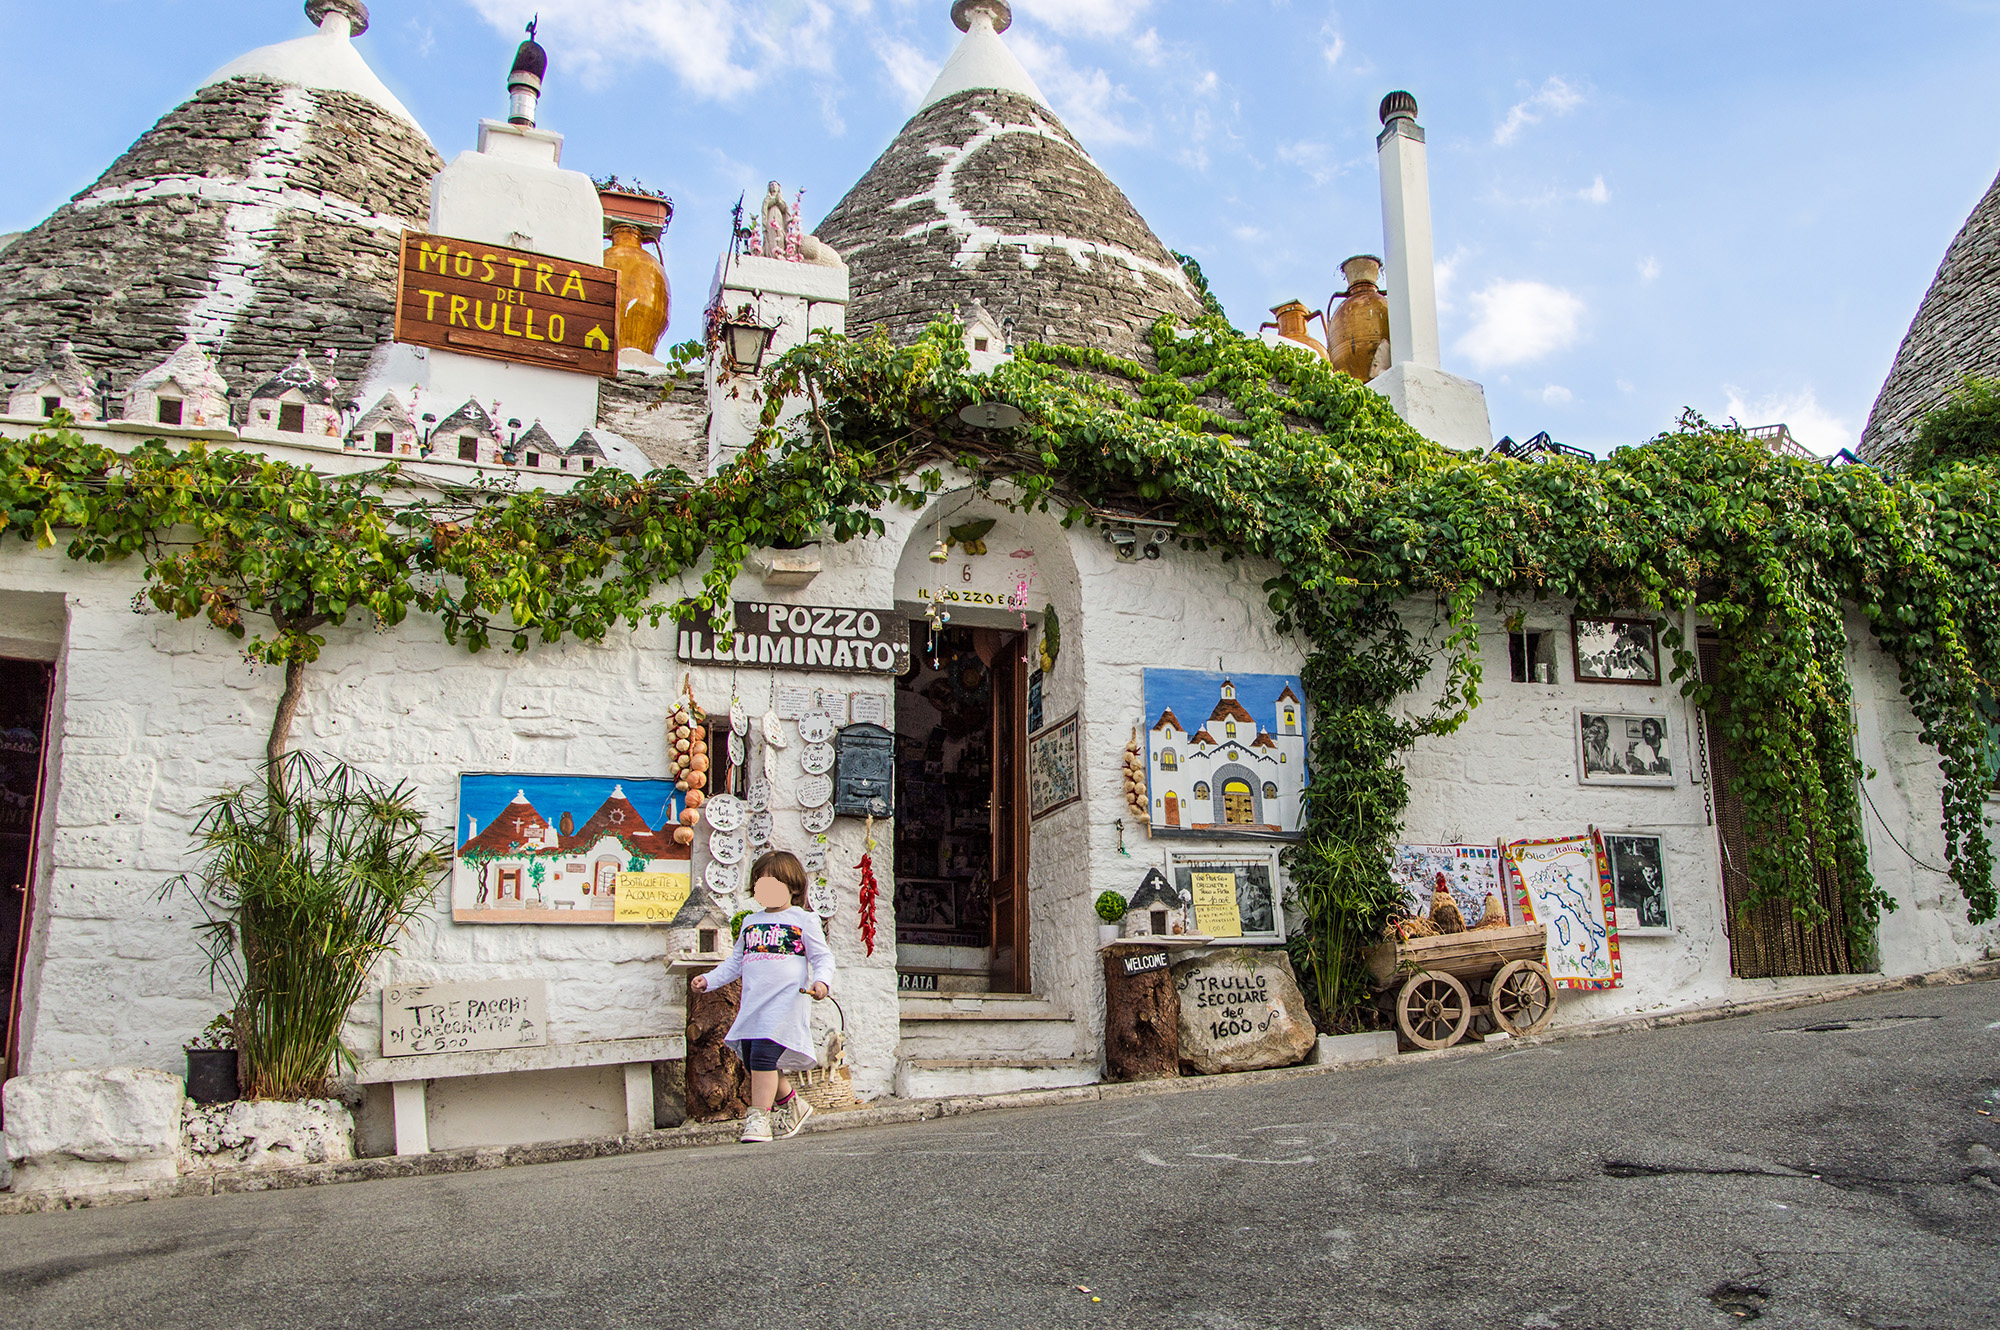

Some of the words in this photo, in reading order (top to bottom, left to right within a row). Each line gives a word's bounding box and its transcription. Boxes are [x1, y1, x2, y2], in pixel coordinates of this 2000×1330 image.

[418, 241, 586, 301] MOSTRA
[497, 287, 528, 306] DEL
[418, 289, 565, 343] TRULLO
[962, 564, 972, 582] 6
[918, 588, 931, 599] IL
[625, 889, 655, 901] ACQUA
[657, 891, 685, 901] FRESCA
[745, 930, 784, 948] MAGIC
[1124, 953, 1168, 972] WELCOME
[1195, 975, 1266, 991] TRULLO
[1197, 989, 1268, 1008] SECOLARE
[404, 1001, 461, 1026] TRE
[1221, 1007, 1244, 1018] del
[1209, 1019, 1253, 1039] 1600
